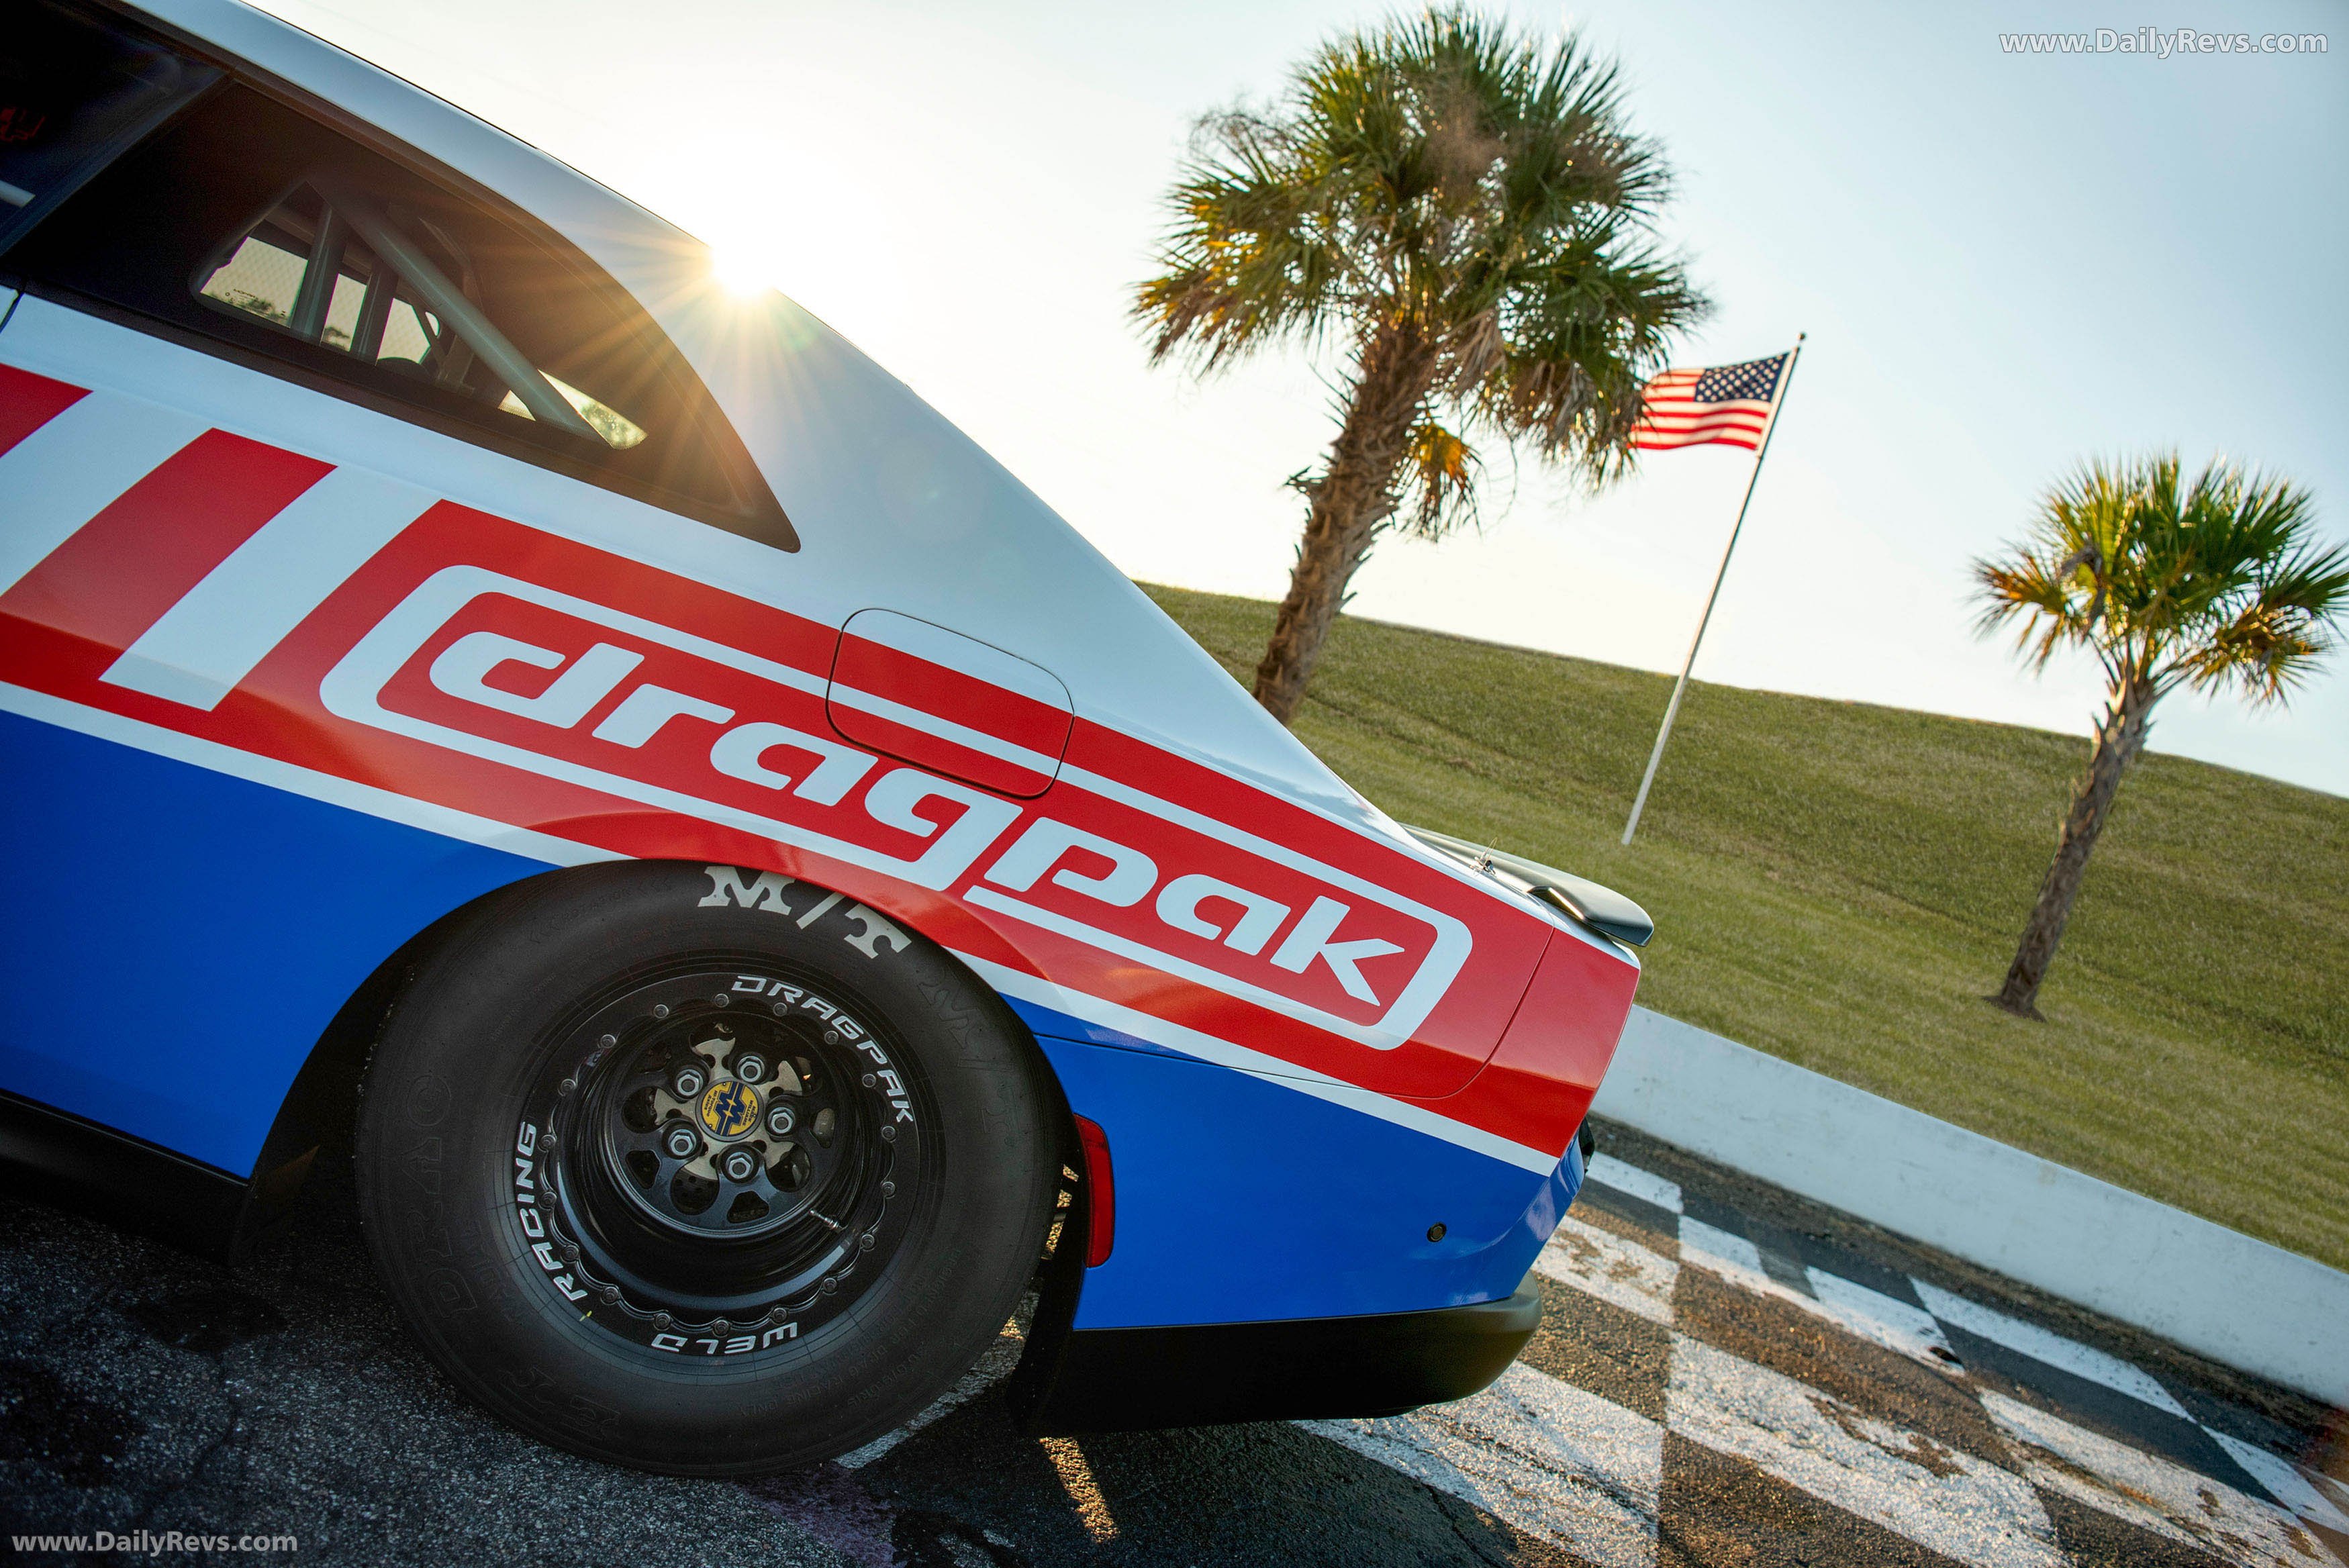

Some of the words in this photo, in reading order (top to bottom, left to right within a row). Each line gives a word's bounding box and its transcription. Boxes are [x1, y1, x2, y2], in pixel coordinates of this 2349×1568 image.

[430, 631, 1405, 1008] dragpak
[697, 865, 912, 959] M/T
[730, 974, 914, 1124] DRAGPAK
[742, 1099, 753, 1126] WILLIAMS
[514, 1120, 588, 1303] RACING
[651, 1320, 799, 1356] WELD
